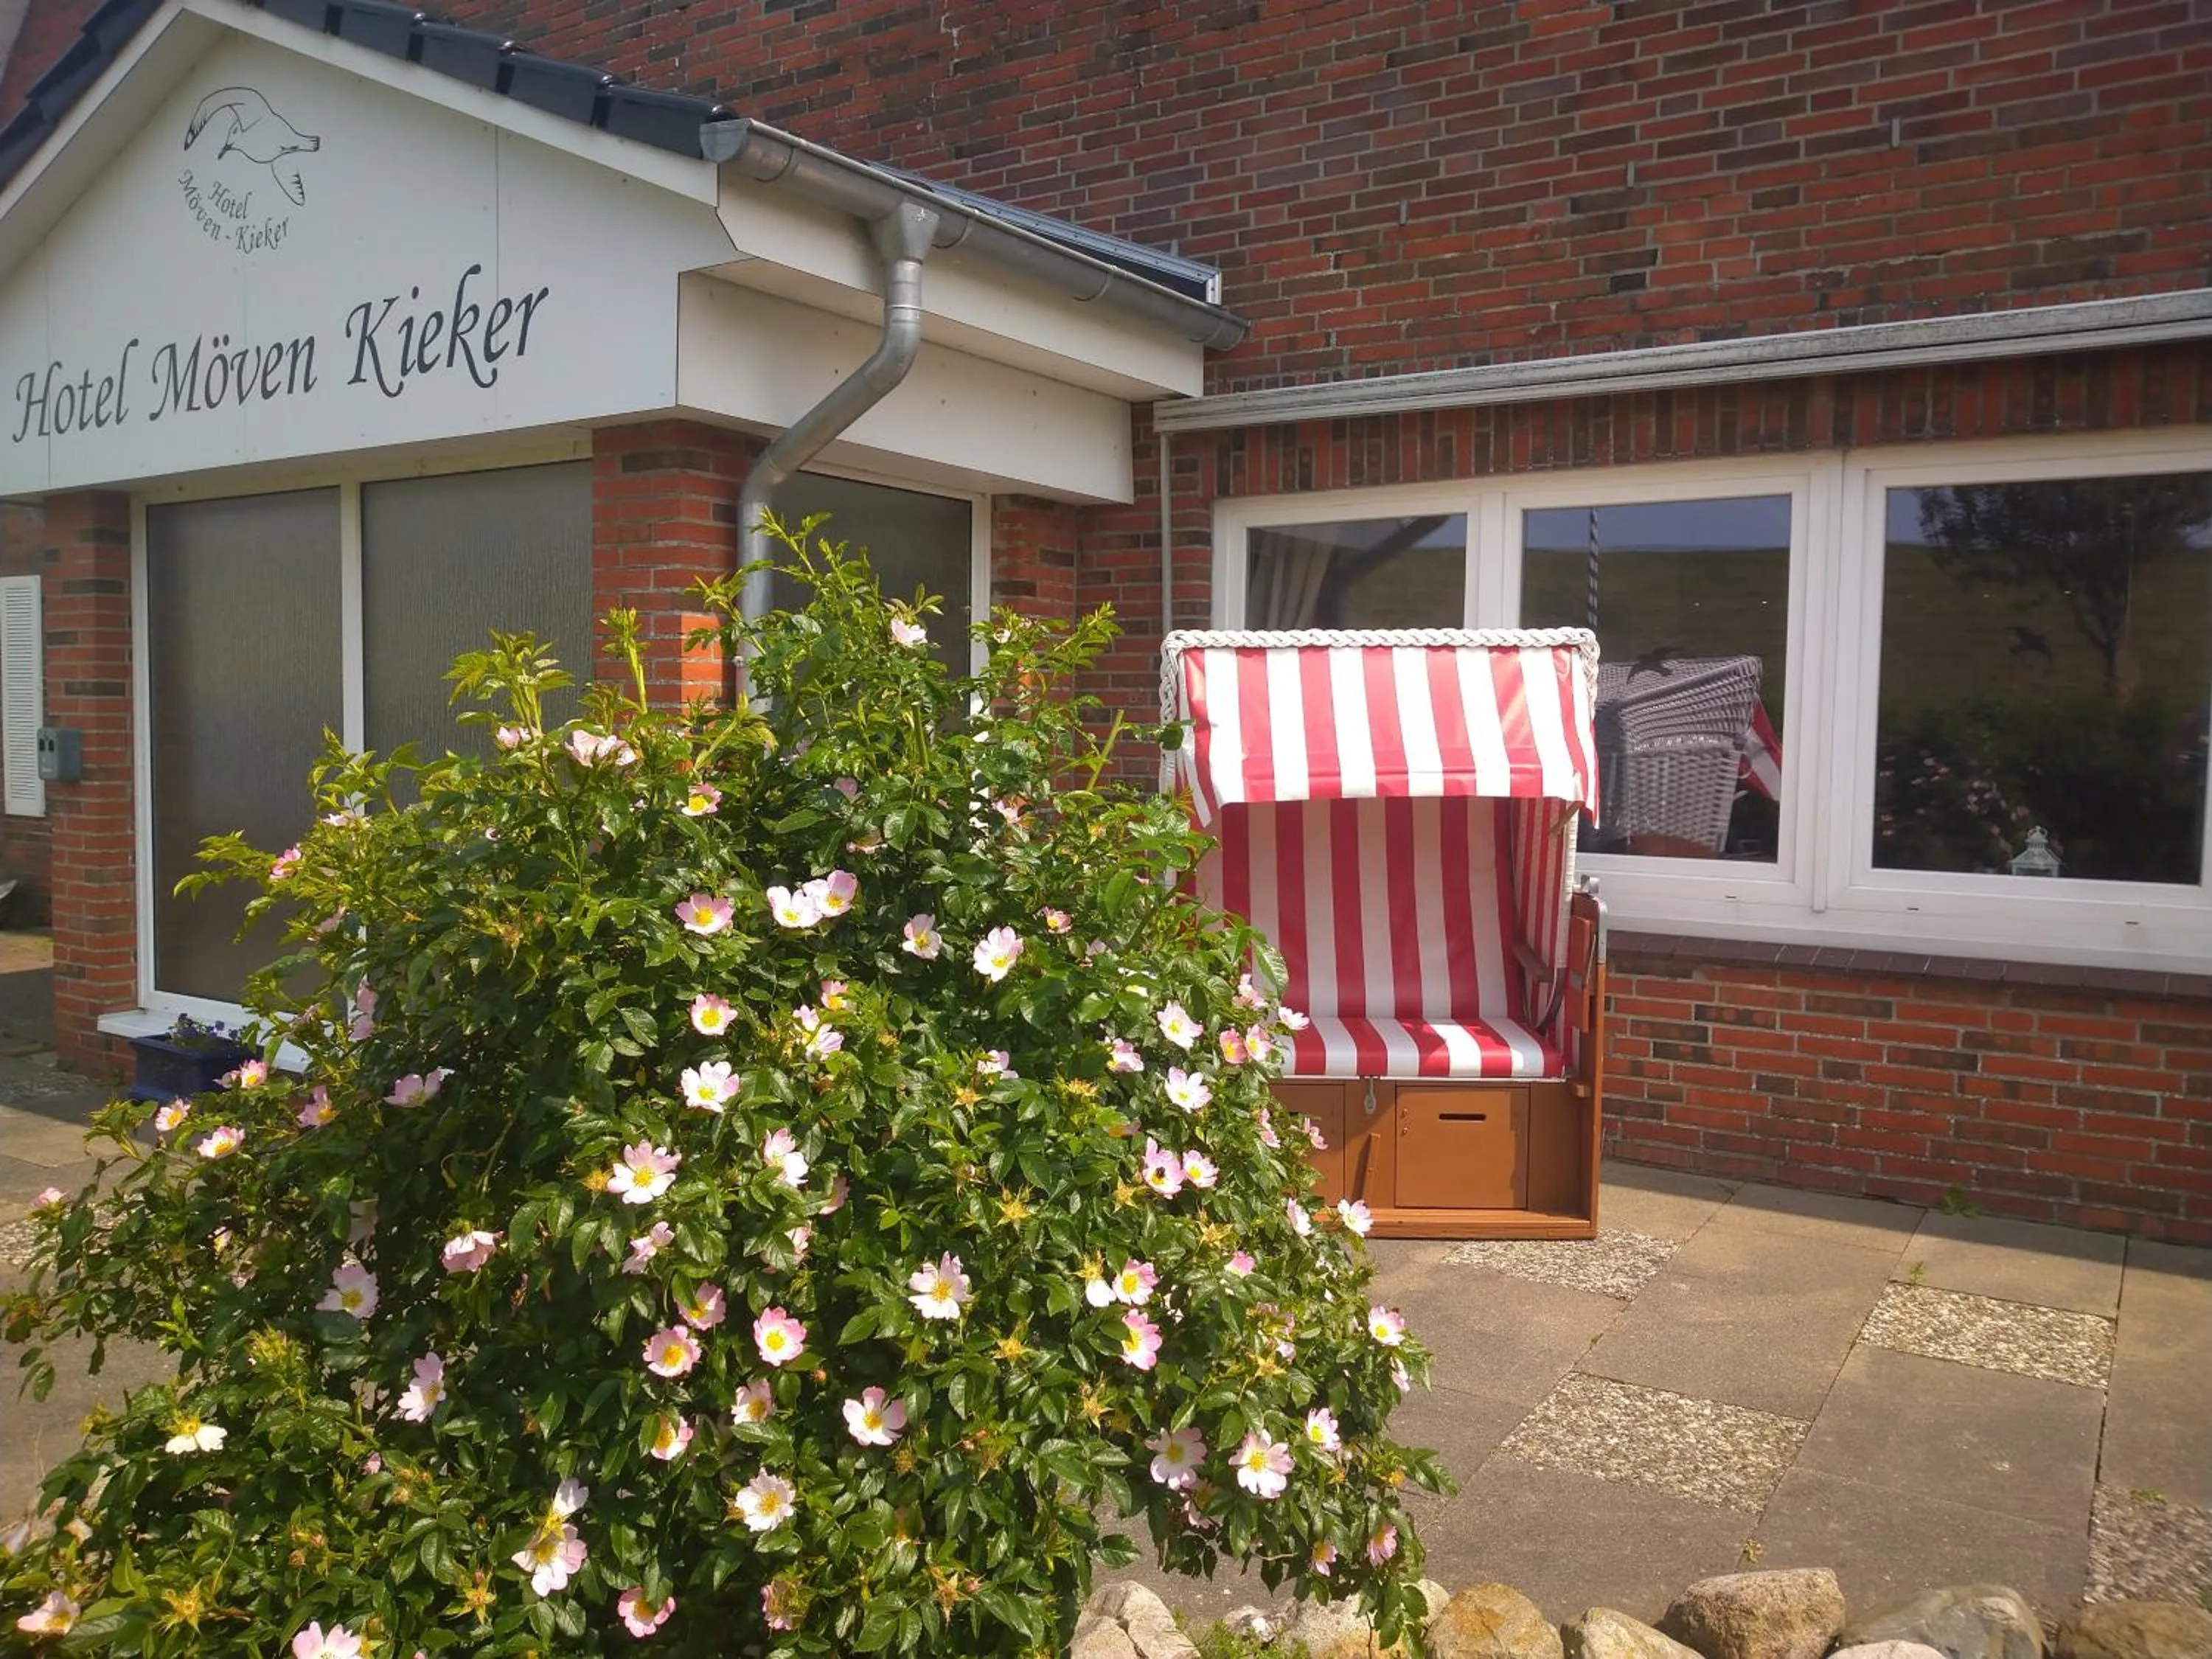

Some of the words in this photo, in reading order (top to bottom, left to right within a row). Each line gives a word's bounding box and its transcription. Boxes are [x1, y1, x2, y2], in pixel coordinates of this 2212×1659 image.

[208, 181, 253, 219] Hotel
[12, 338, 139, 442] Hotel
[148, 333, 318, 421] Möven
[345, 263, 549, 398] Kieker
